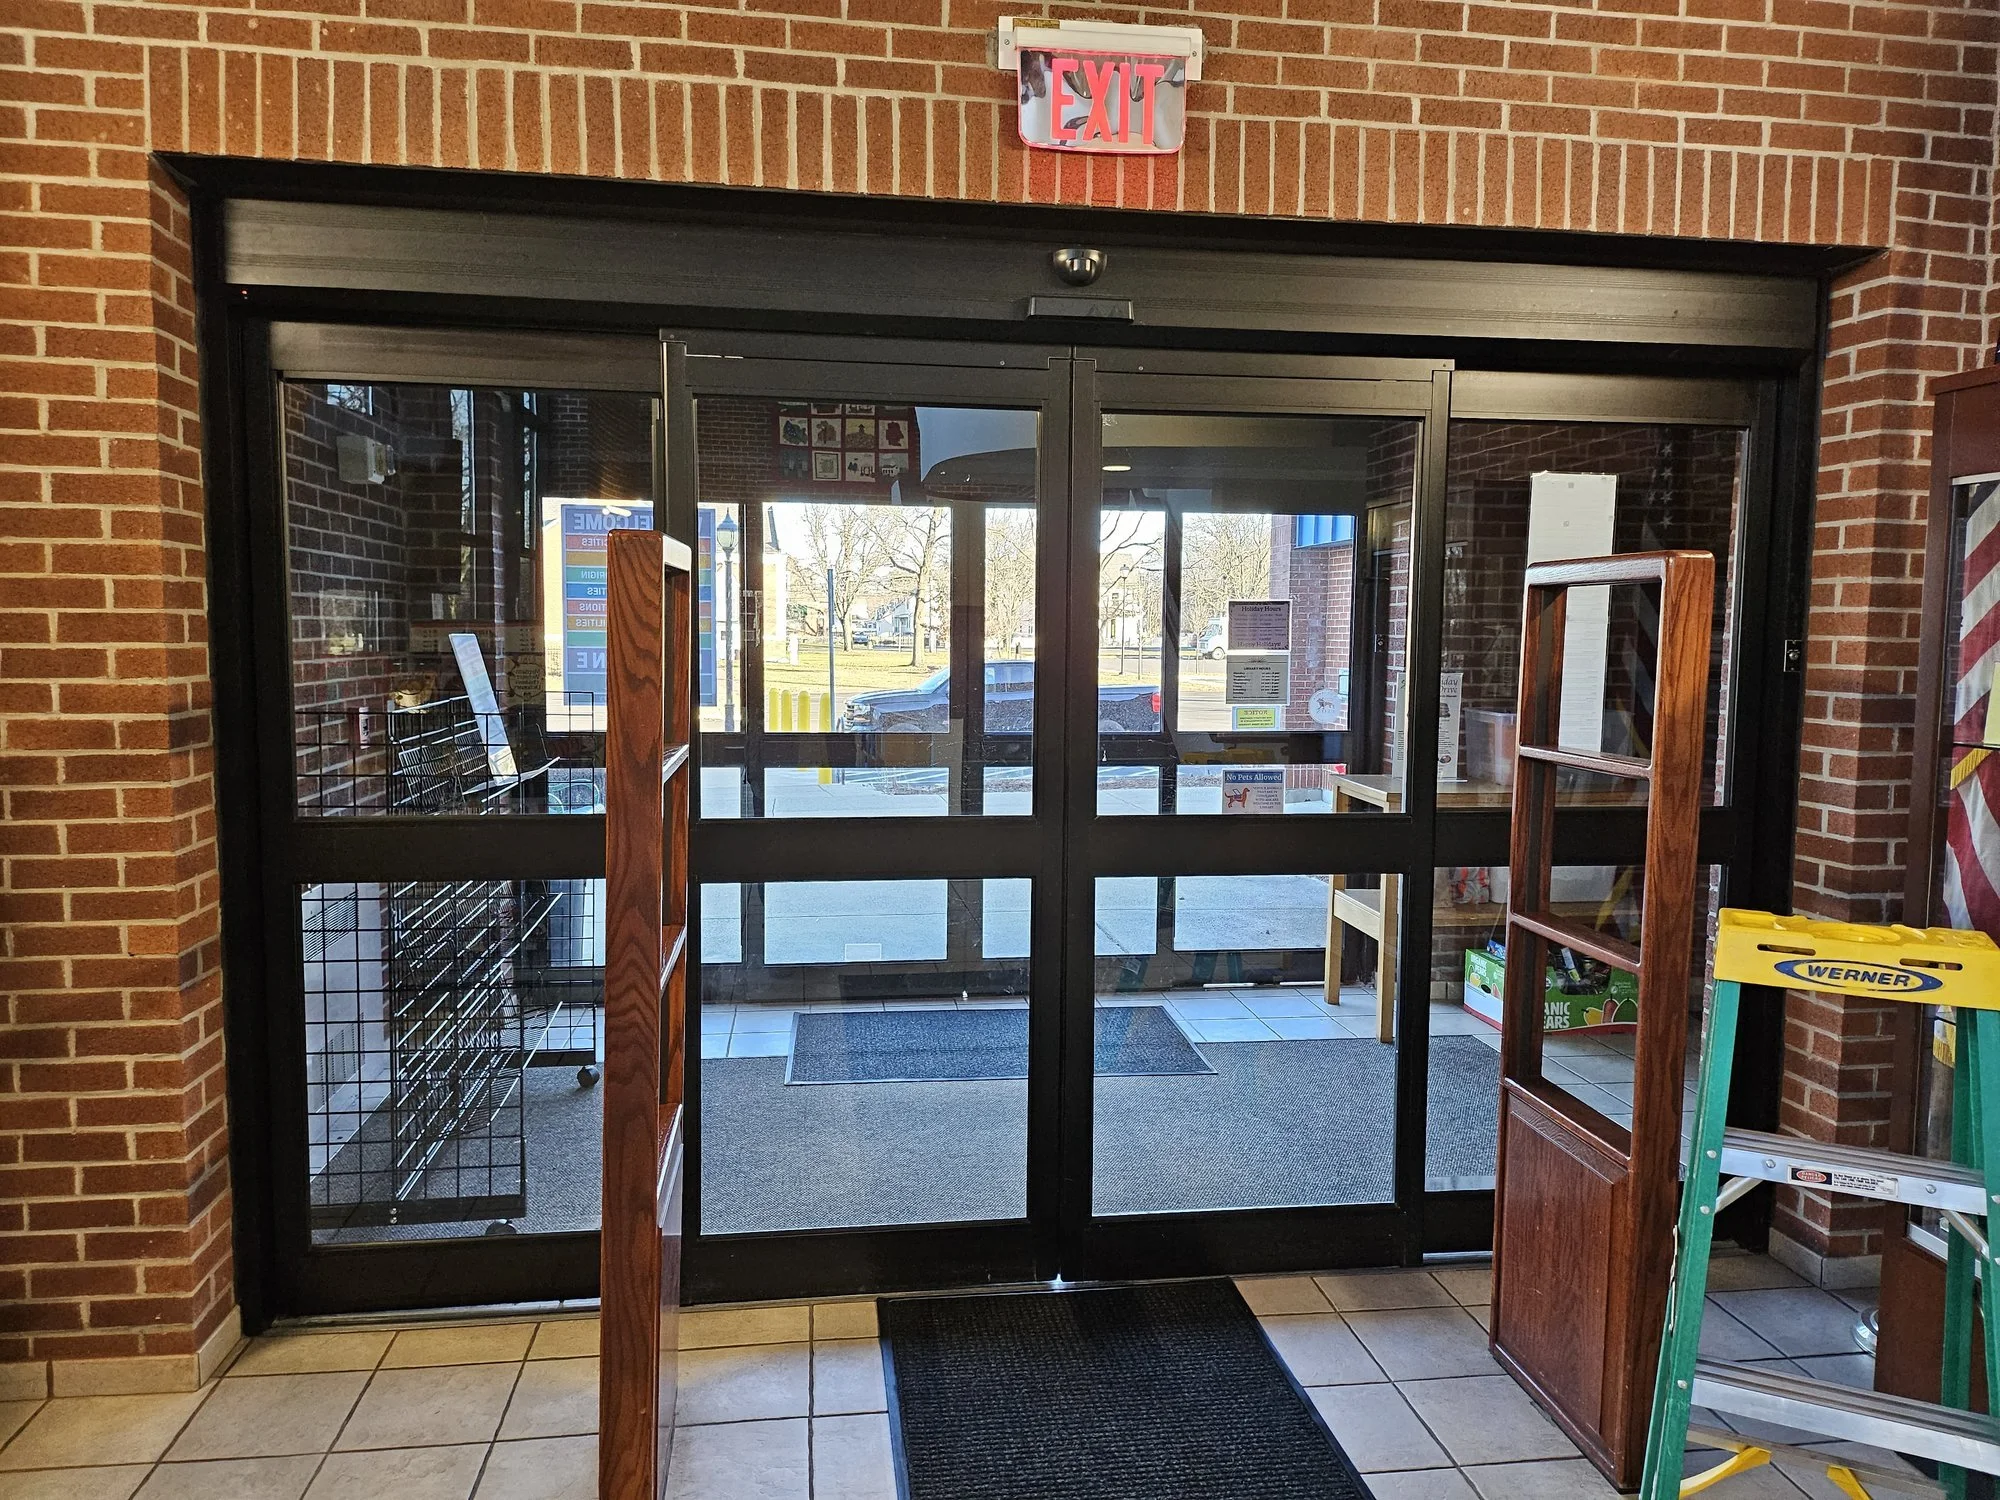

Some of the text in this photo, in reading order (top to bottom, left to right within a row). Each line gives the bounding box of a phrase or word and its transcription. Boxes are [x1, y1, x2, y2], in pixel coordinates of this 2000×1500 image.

[1050, 58, 1165, 145] EXIT
[1226, 773, 1282, 781] No Pets Allowed
[1806, 965, 1911, 987] WERNER
[1544, 1002, 1570, 1016] ANIC
[1544, 1016, 1570, 1029] ARS
